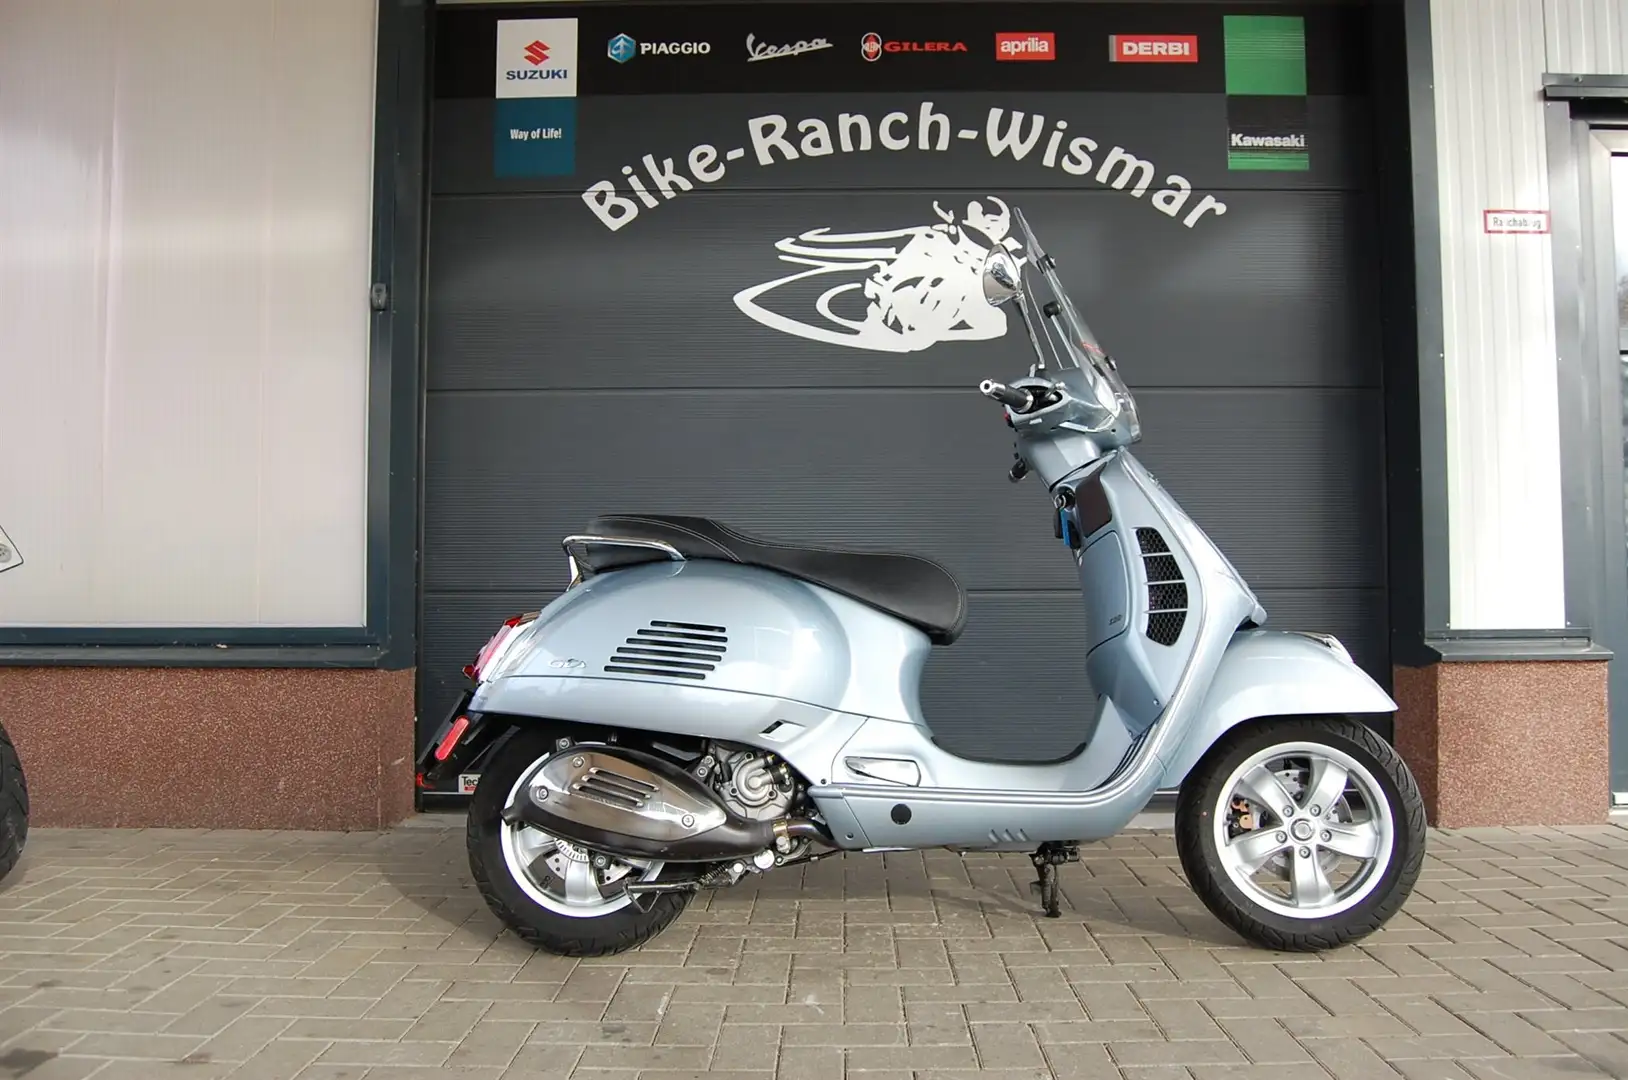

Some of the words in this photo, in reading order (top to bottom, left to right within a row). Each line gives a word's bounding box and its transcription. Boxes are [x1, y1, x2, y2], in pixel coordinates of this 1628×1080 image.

[639, 41, 711, 56] PIAGGIO
[746, 33, 834, 62] Vespa
[883, 41, 968, 53] GILERA
[1000, 38, 1049, 56] aprilia
[1122, 41, 1190, 56] DERBI
[506, 69, 568, 80] SUZUKI
[510, 128, 529, 142] Way
[530, 128, 541, 140] of
[542, 128, 562, 139] Life!
[1230, 133, 1306, 149] Kawasaki
[582, 101, 1227, 232] Bike-Ranch-Wismar
